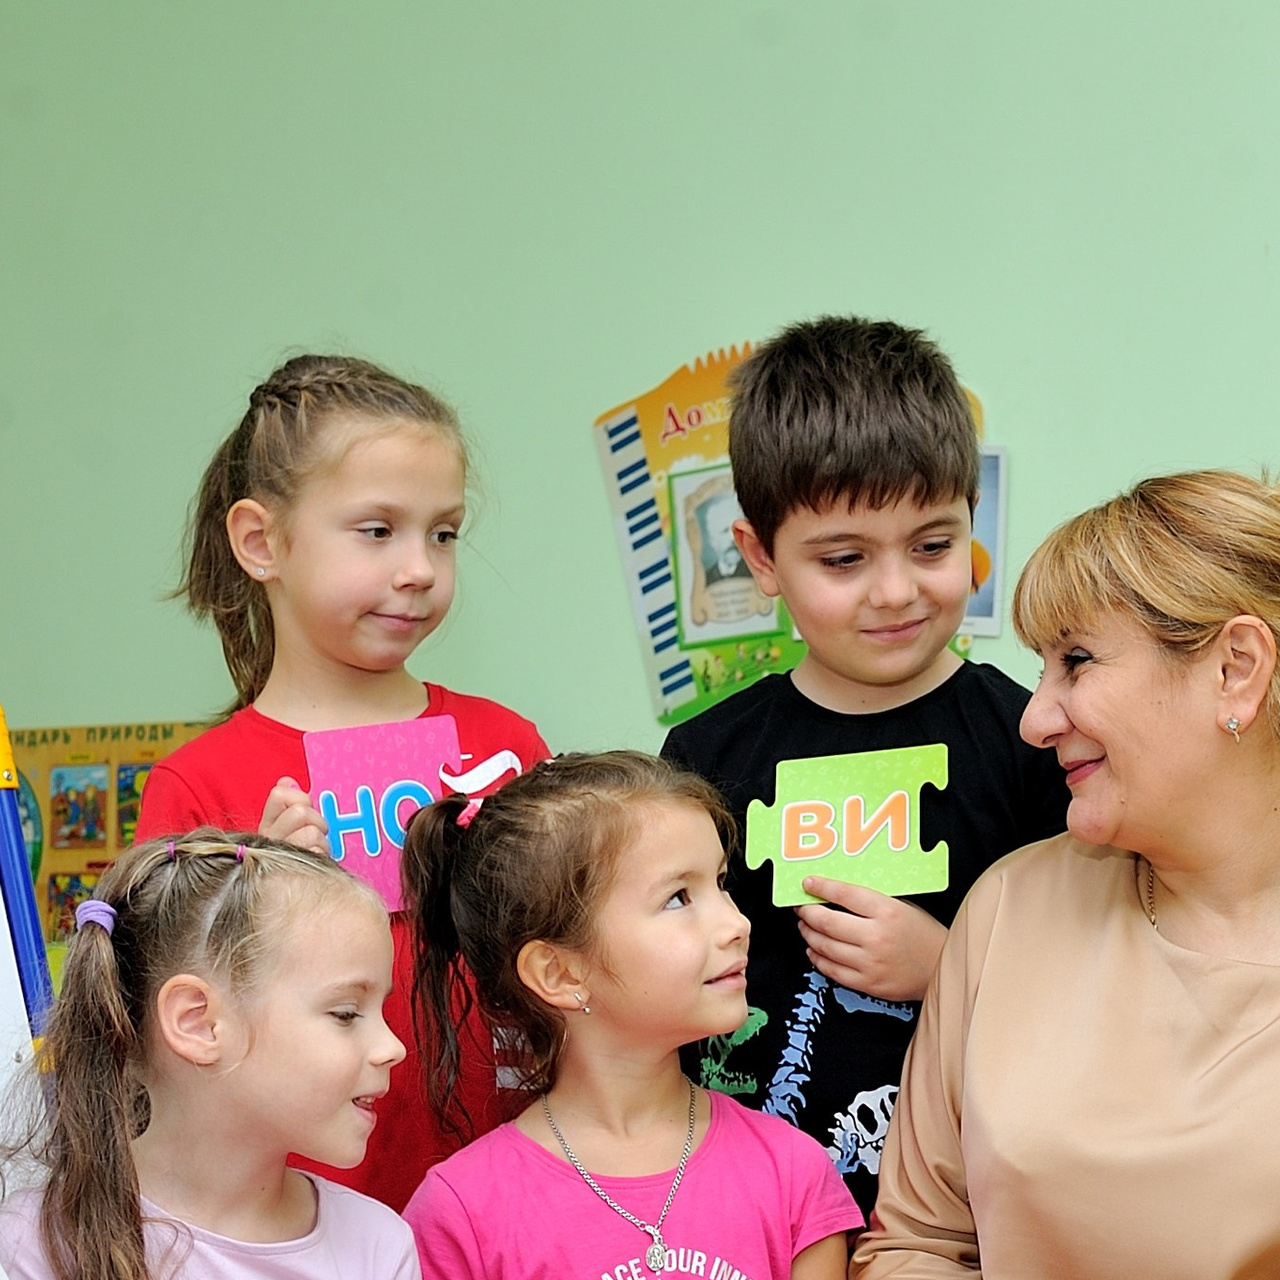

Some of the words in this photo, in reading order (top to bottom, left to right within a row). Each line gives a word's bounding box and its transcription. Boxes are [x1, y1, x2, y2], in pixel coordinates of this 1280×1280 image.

[86, 724, 174, 742] ПРИРОДЫ
[319, 779, 435, 861] НО
[781, 790, 909, 861] ВИ
[664, 1247, 707, 1277] OUR
